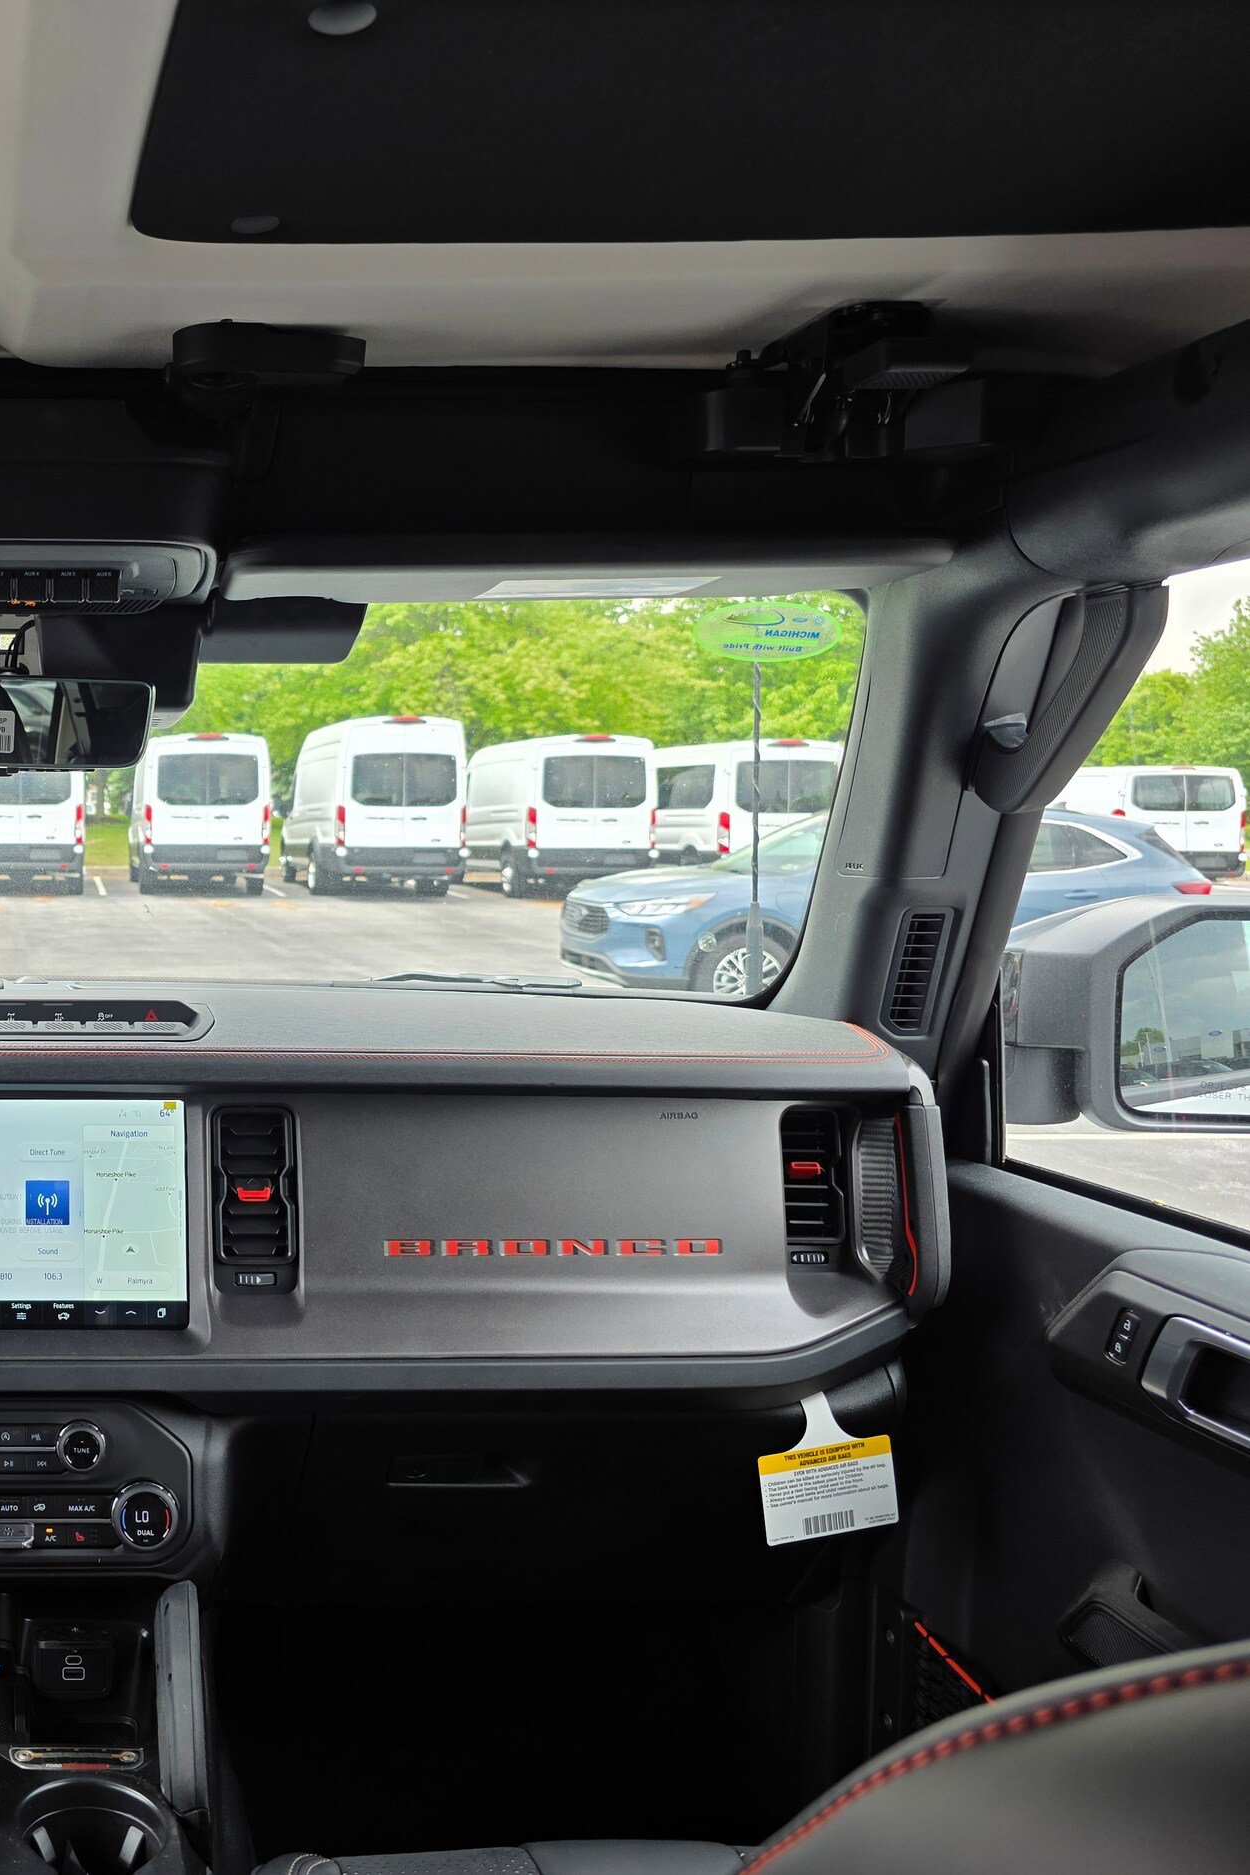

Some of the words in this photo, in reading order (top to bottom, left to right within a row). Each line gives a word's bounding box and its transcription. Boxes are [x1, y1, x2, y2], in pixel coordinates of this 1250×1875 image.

[1200, 1081, 1247, 1091] OBJECTS
[1192, 1090, 1231, 1100] CLOSER
[658, 1111, 699, 1120] AIRBAG
[110, 1130, 148, 1138] Navigation
[30, 1148, 49, 1156] Direct
[50, 1148, 65, 1156] Tune
[383, 1238, 723, 1257] BRONCO
[0, 1272, 13, 1281] 810
[43, 1272, 63, 1281] 106.3
[797, 1450, 819, 1459] VEHICLE
[826, 1445, 851, 1454] EQUIPPED
[800, 1457, 827, 1466] ADVANCED
[818, 1464, 839, 1472] ADVANCED
[135, 1510, 150, 1523] LO
